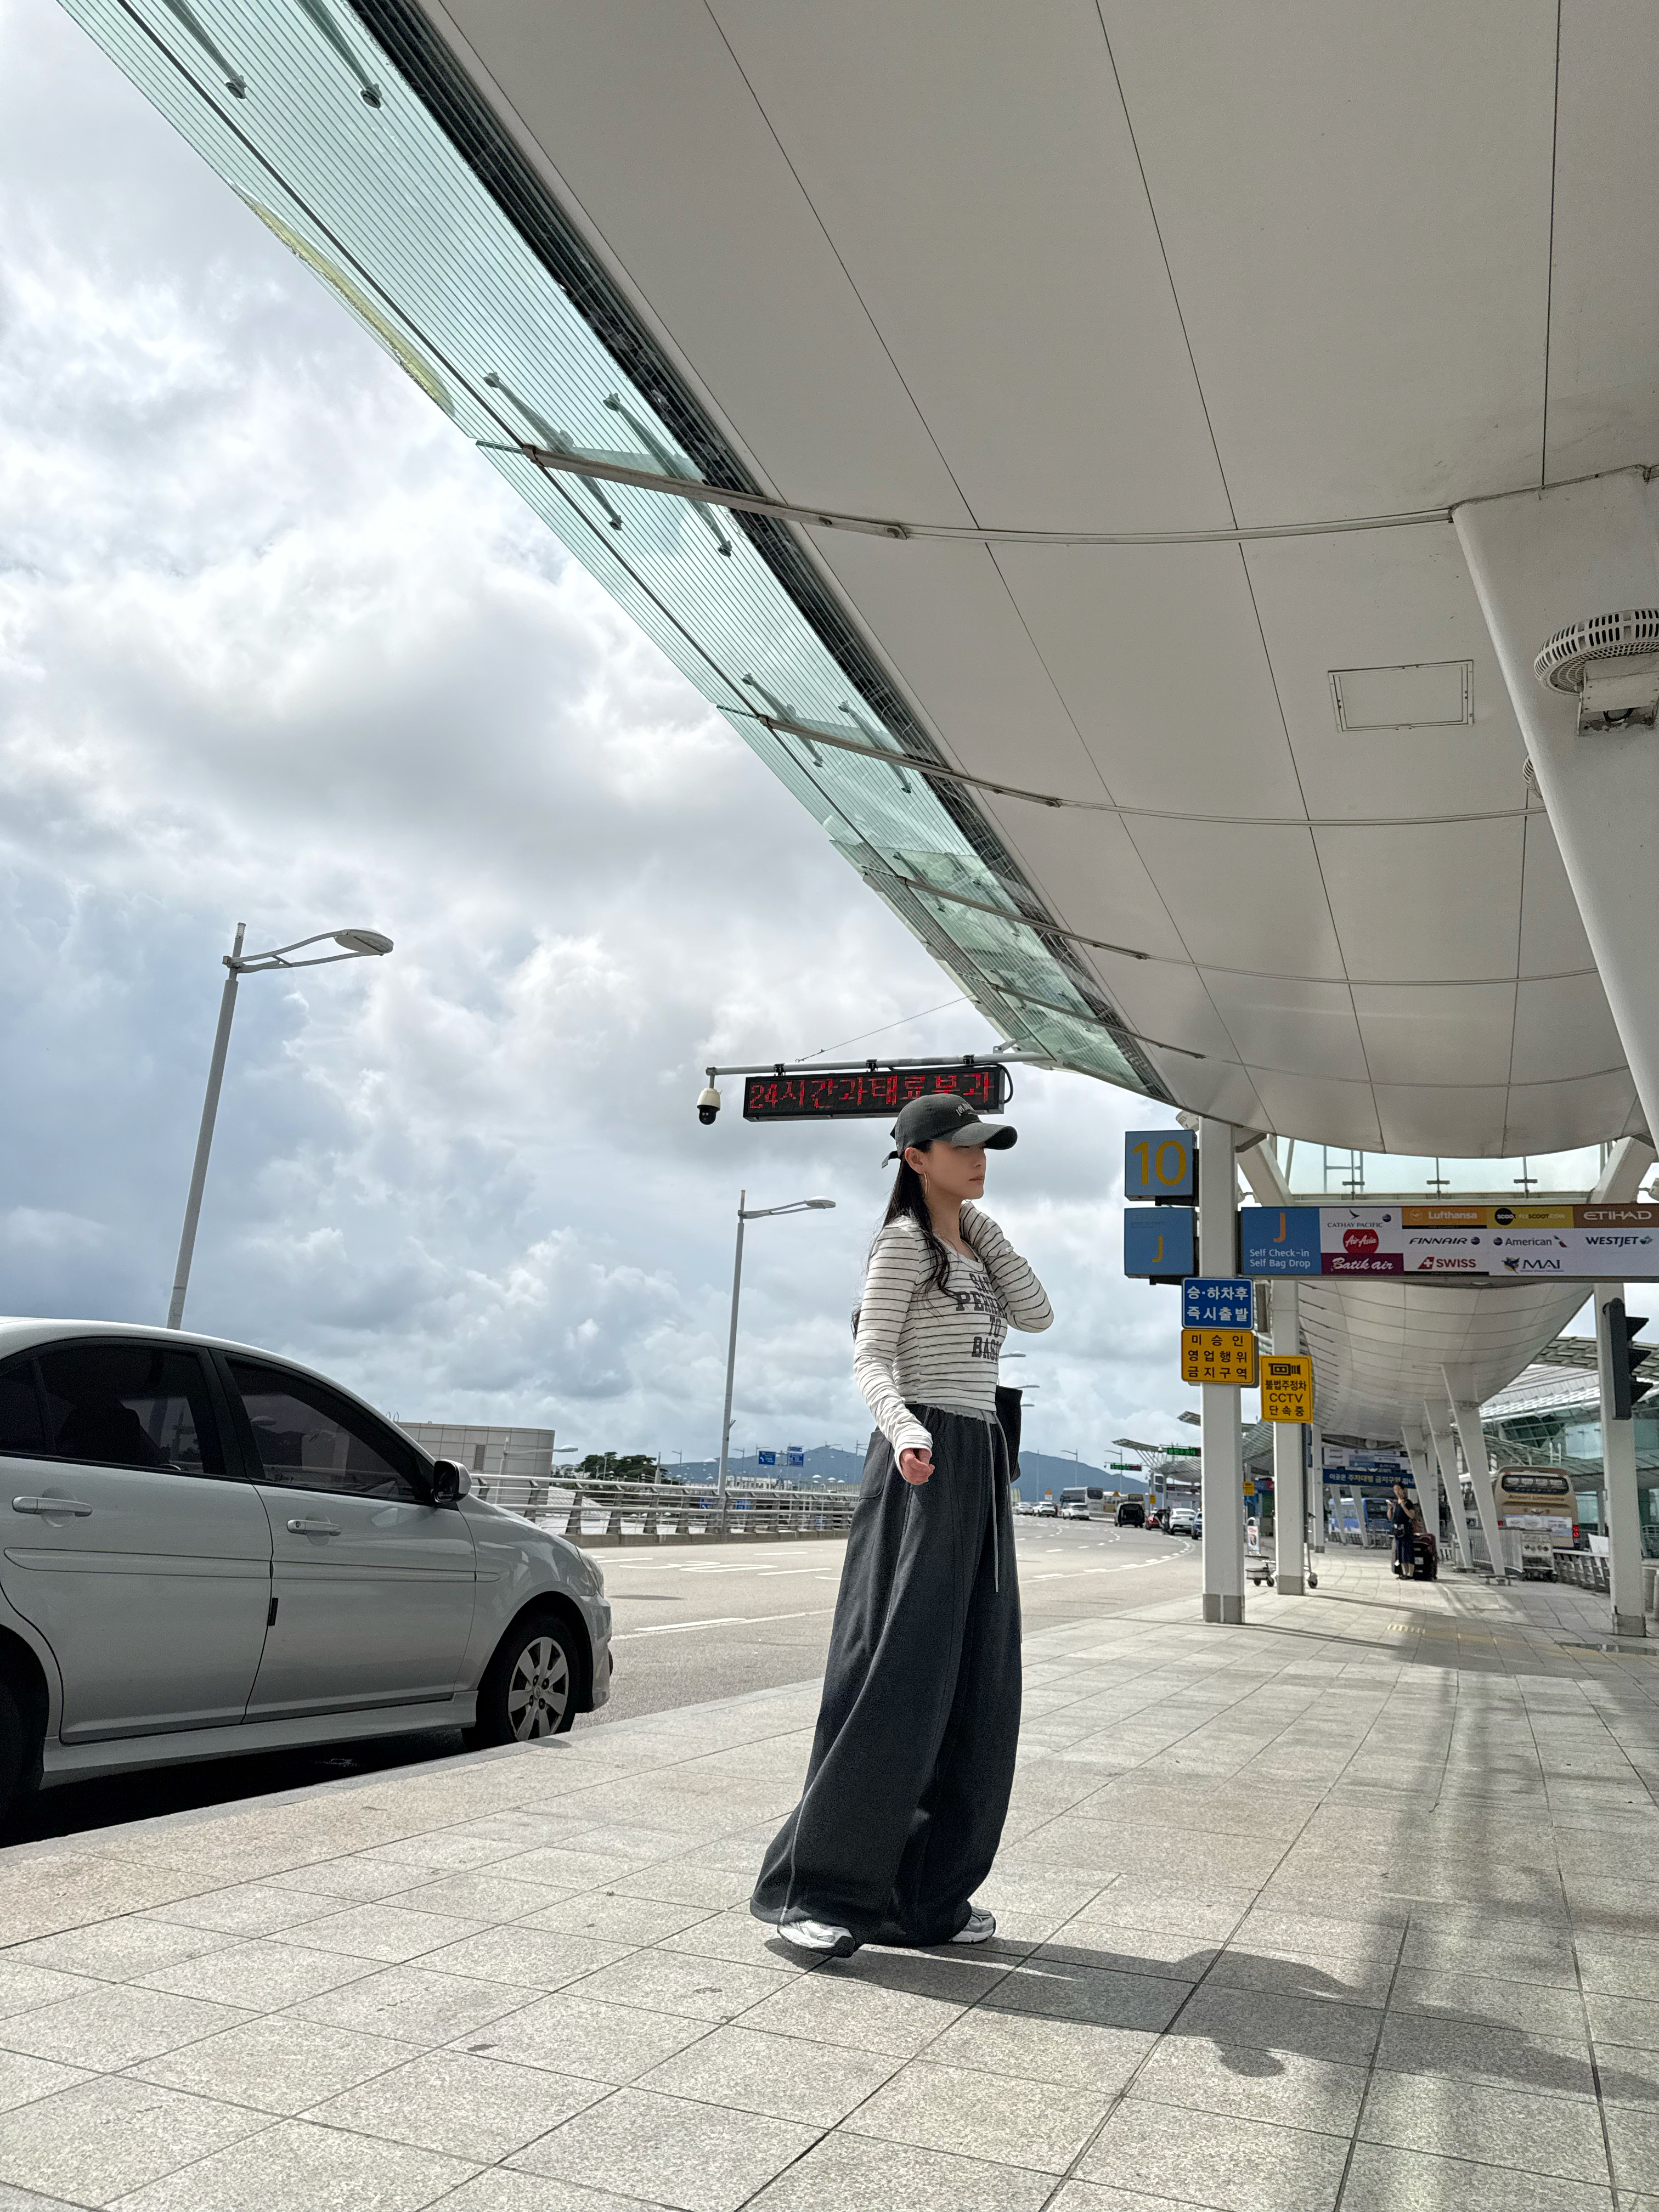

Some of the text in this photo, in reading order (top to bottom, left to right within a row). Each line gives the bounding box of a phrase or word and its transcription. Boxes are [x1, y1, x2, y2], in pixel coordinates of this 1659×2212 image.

[1132, 1140, 1187, 1186] 10
[1429, 1211, 1477, 1220] Lufthansa
[1583, 1210, 1652, 1220] ETIHAD
[1274, 1212, 1286, 1242] J
[1152, 1234, 1163, 1262] J
[1505, 1238, 1552, 1246] American
[1585, 1237, 1639, 1247] WESTJET
[1250, 1249, 1310, 1257] Self Check-in
[1250, 1259, 1311, 1269] Self Bag Drop
[1331, 1257, 1370, 1271] Batik
[1436, 1259, 1476, 1268] SWISS
[1522, 1260, 1561, 1269] MAI
[1187, 1286, 1249, 1301] 승·하차후
[1187, 1306, 1249, 1322] 즉시출발
[988, 1316, 1001, 1338] TO
[1188, 1350, 1247, 1363] 영업행위
[1188, 1366, 1247, 1379] 금지구역
[1265, 1379, 1307, 1391] 불법주정차
[1269, 1392, 1303, 1403] CCTV
